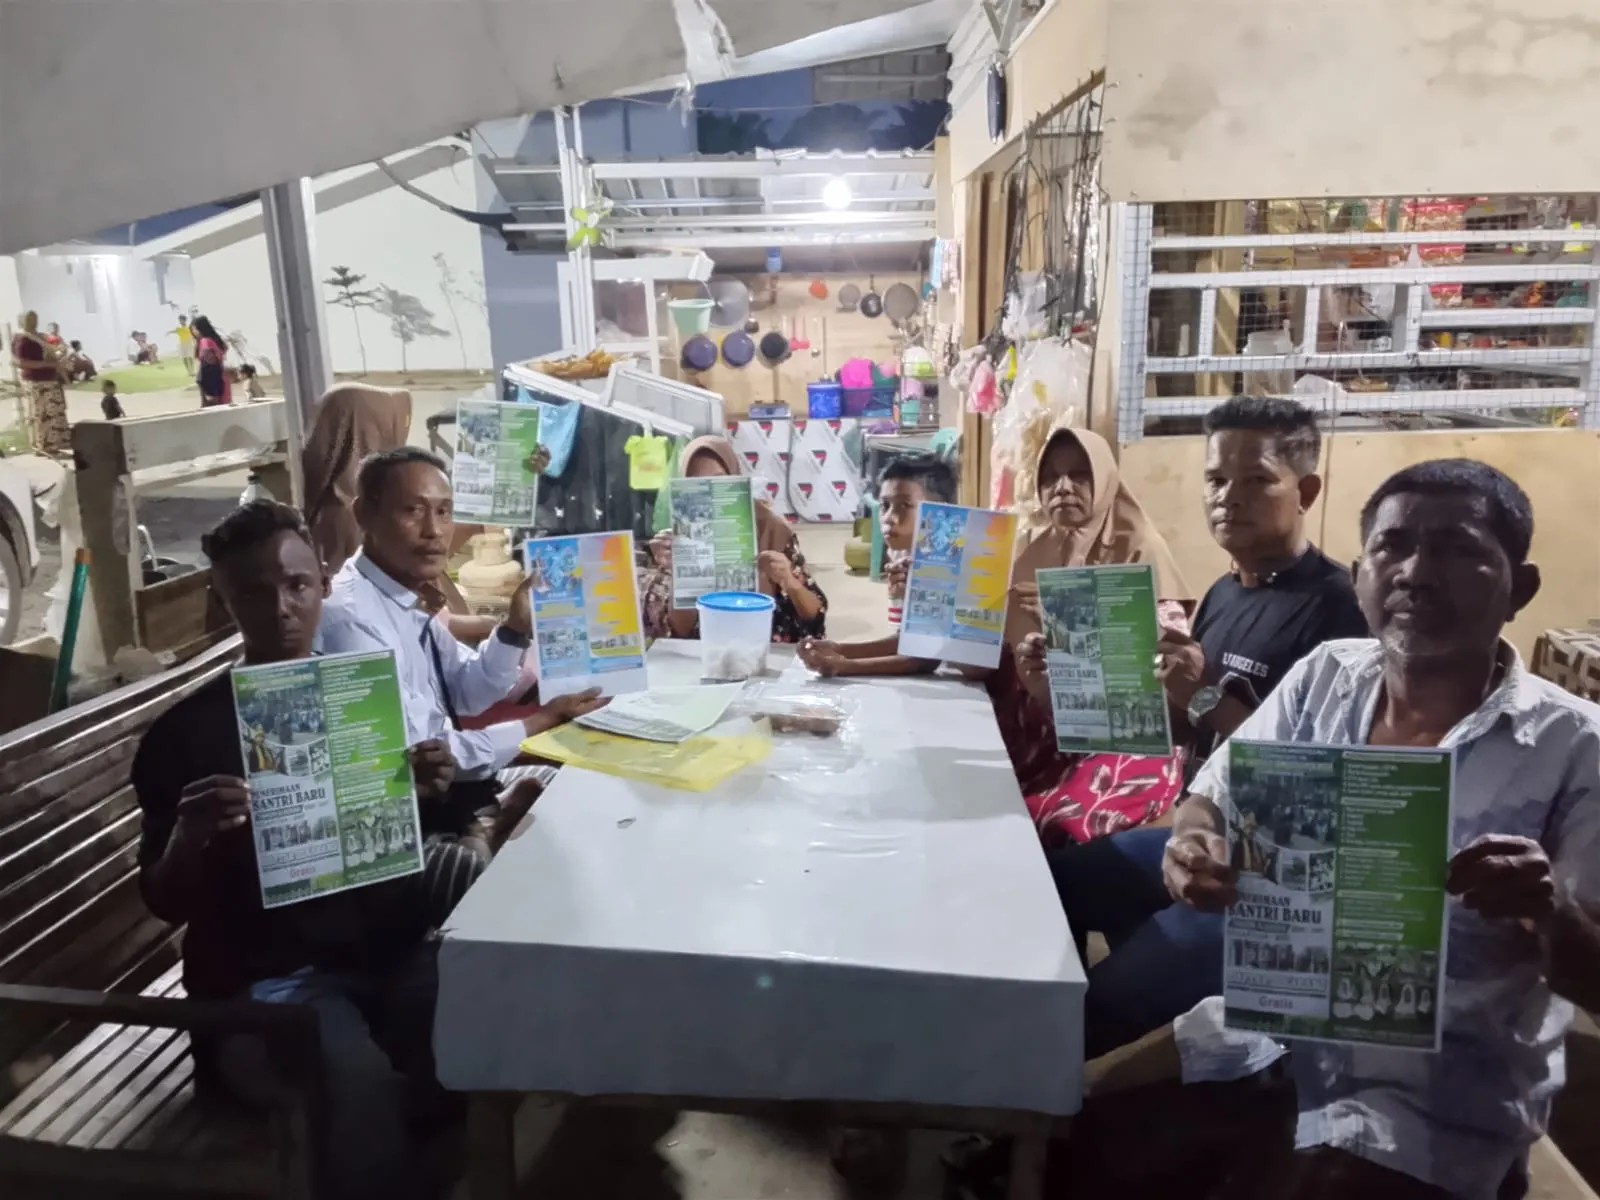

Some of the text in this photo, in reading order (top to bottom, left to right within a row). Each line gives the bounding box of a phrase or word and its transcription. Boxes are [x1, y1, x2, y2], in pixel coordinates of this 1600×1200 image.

[253, 787, 326, 812] SANTRI BARU
[1283, 907, 1323, 924] BARU
[1258, 995, 1294, 1010] Gratis
